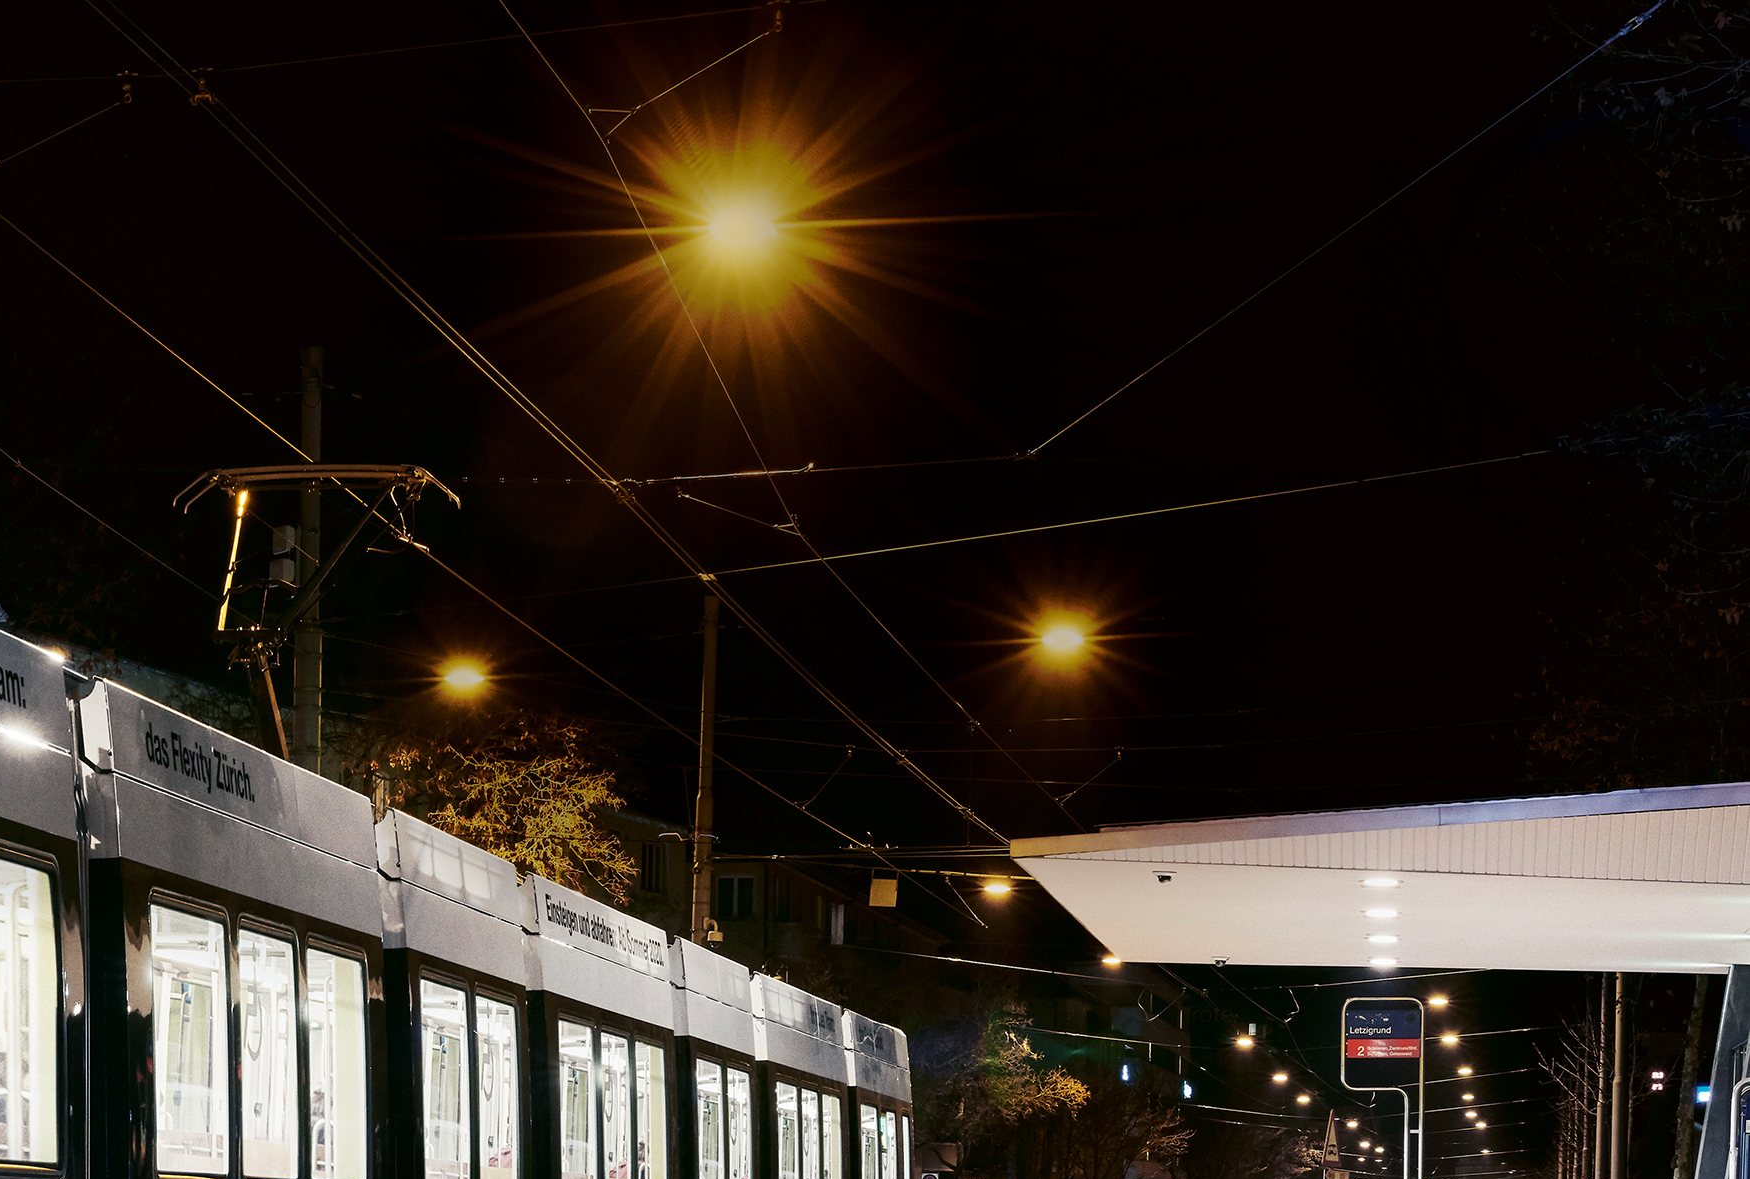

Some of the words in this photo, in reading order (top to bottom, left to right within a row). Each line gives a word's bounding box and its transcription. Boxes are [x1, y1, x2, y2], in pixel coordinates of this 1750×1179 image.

[145, 722, 170, 769] das
[171, 731, 211, 794] Flexity
[213, 749, 255, 803] Zürich.
[545, 893, 578, 936] Einsteigen
[578, 911, 590, 938] und
[1349, 1026, 1392, 1036] Letzigrund
[1357, 1046, 1365, 1056] 2
